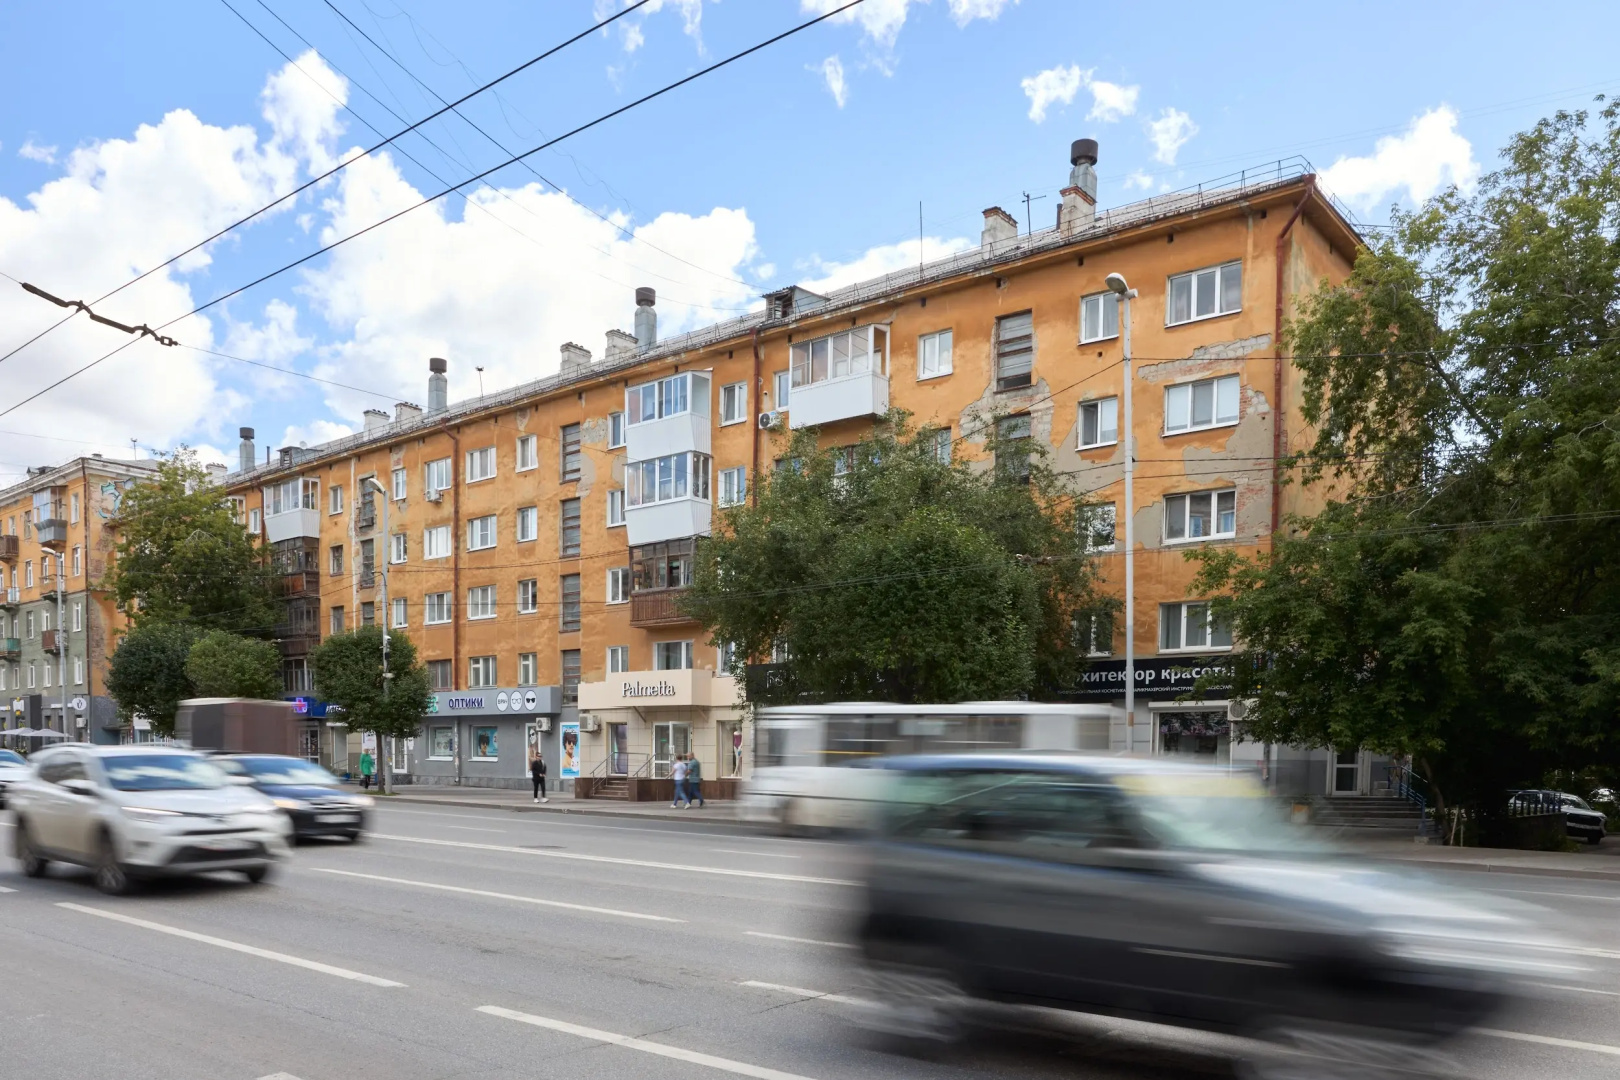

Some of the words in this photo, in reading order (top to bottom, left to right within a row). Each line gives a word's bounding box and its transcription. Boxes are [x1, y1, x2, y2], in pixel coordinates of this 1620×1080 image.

[1077, 670, 1155, 685] хитекор
[622, 680, 676, 698] Palmetta
[448, 697, 484, 709] ОПТИКИ
